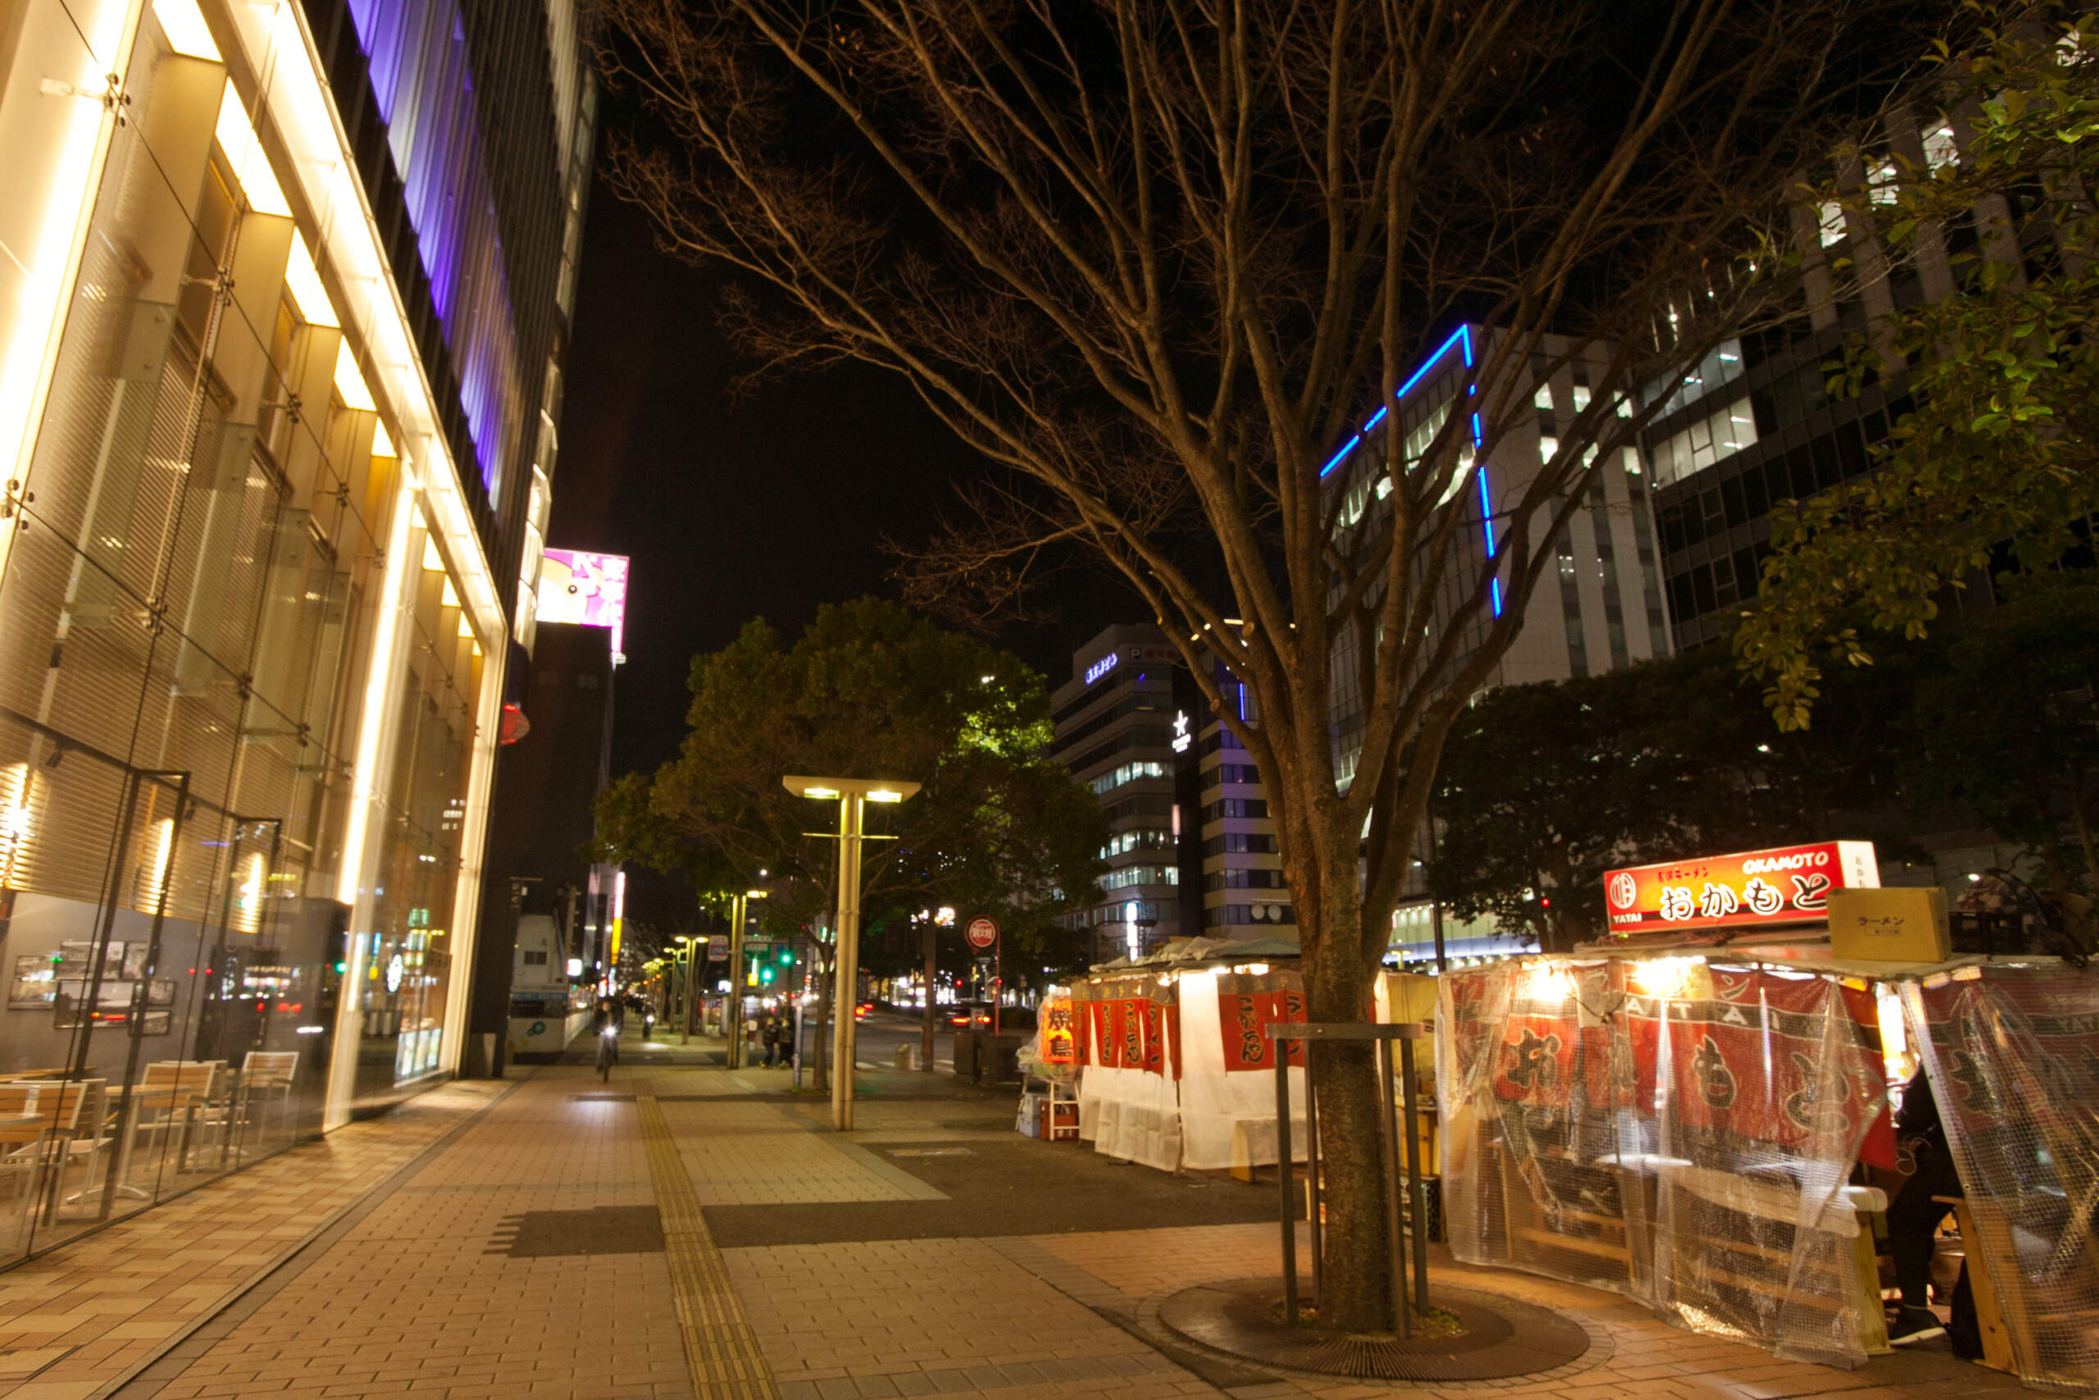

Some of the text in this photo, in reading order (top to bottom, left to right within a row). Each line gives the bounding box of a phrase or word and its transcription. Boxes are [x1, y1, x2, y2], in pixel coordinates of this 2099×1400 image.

[1742, 852, 1829, 874] OKAMOTO
[1660, 873, 1831, 922] おかもと
[1613, 913, 1642, 924] YATAI
[1857, 916, 1905, 926] ラーメン
